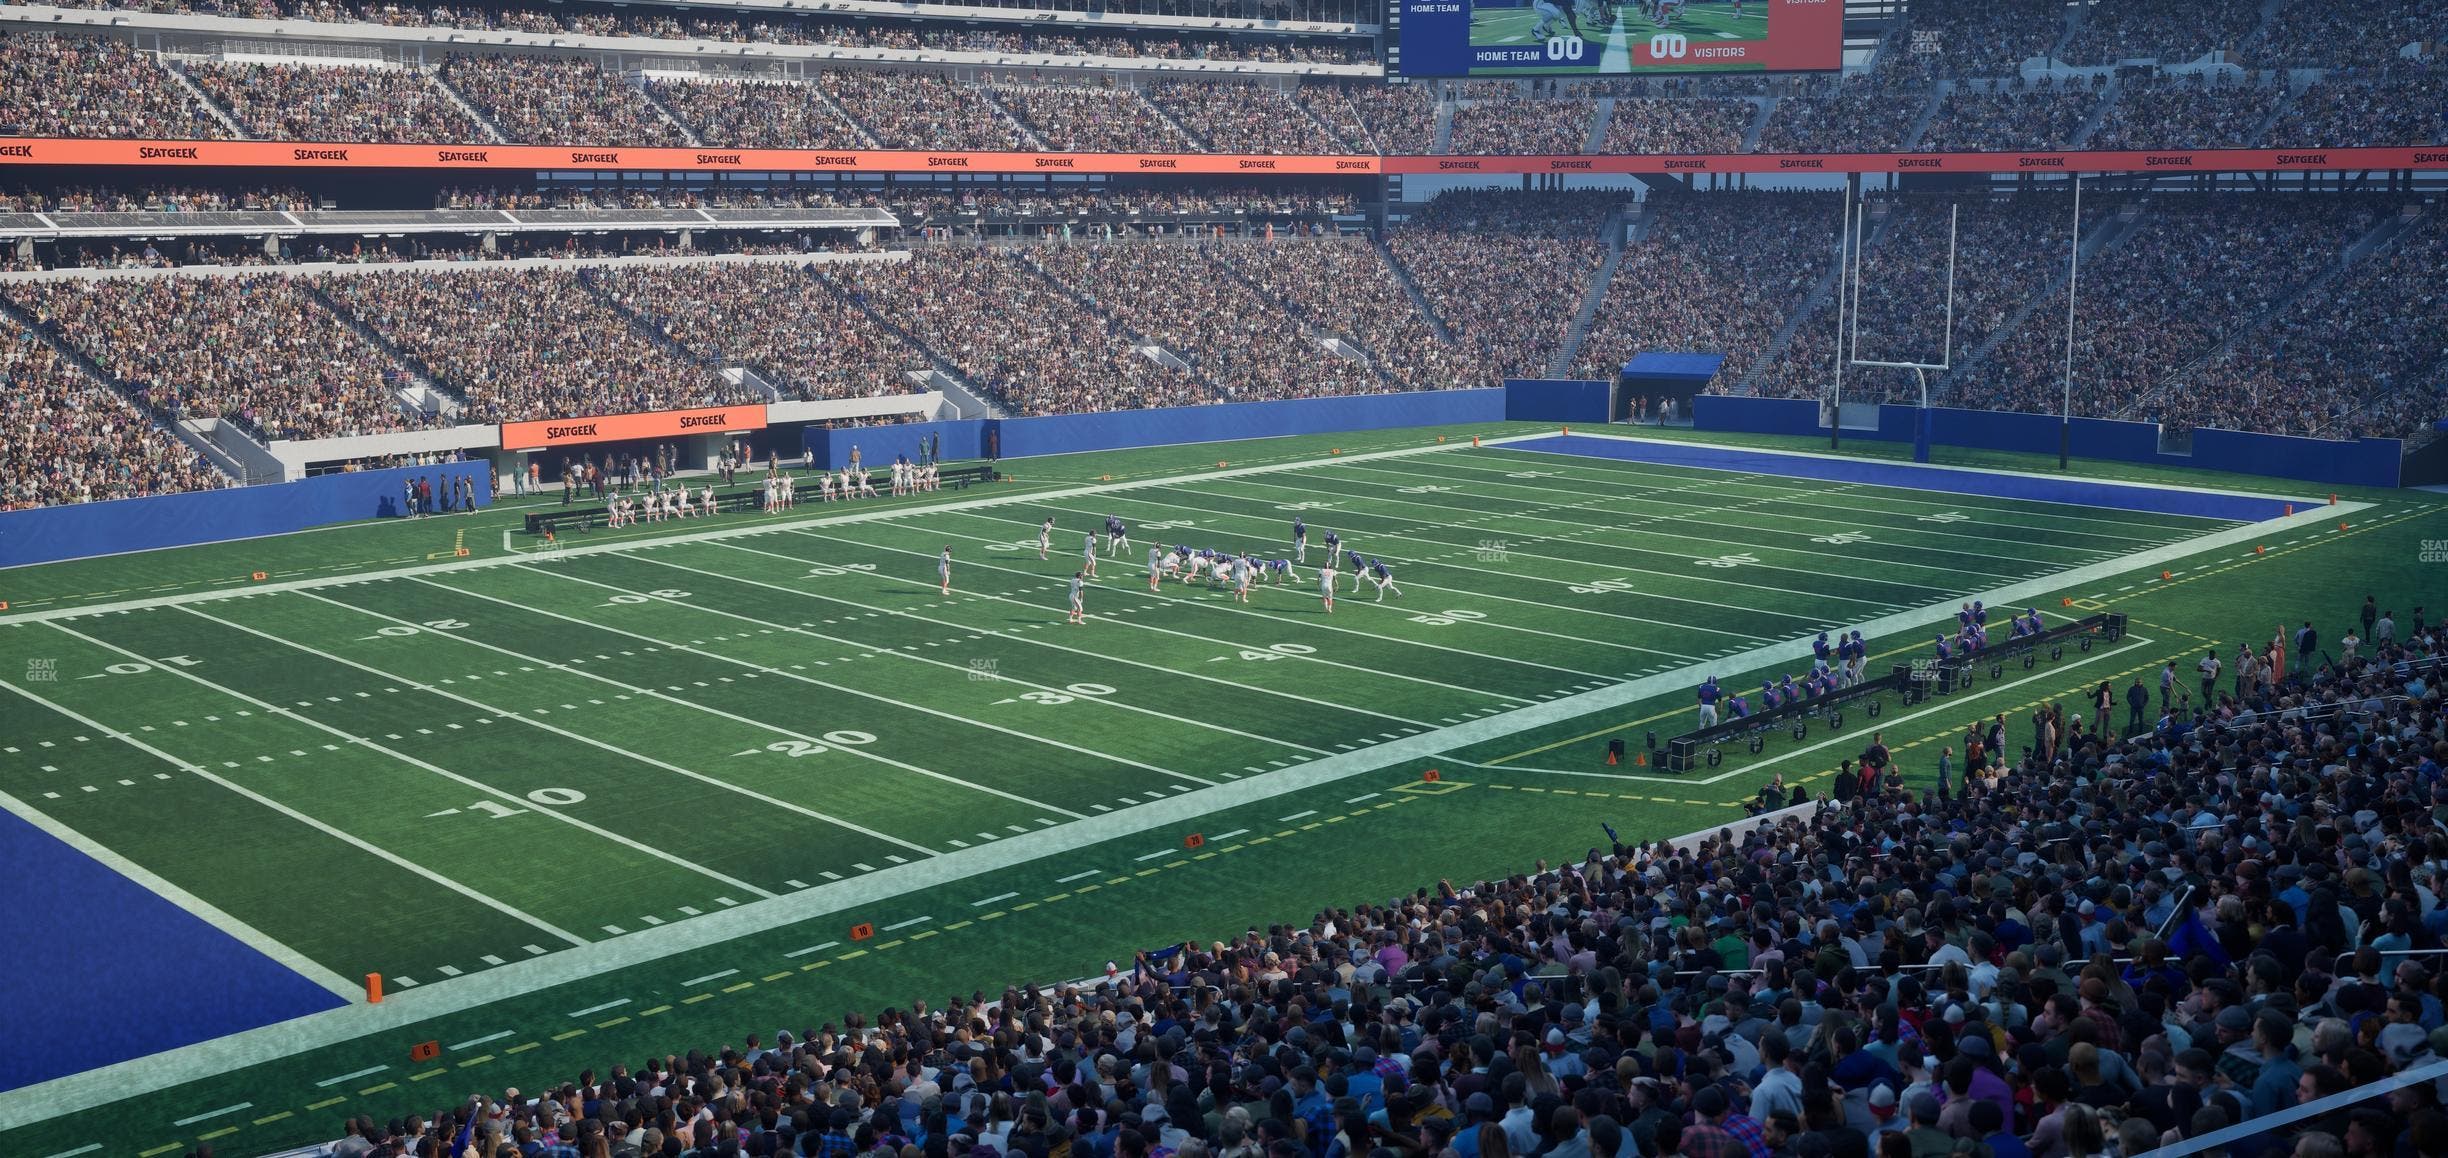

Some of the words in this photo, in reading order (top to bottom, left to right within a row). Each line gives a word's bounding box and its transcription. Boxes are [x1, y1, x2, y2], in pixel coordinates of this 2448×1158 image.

[1410, 4, 1435, 13] HOME
[1436, 4, 1460, 12] TEAM
[1476, 51, 1508, 61] HOME
[1510, 51, 1540, 61] TEAM
[1547, 36, 1583, 60] 00
[1650, 33, 1687, 58] 00
[1694, 47, 1746, 58] VISITORS
[140, 146, 198, 159] SEATGEEK
[294, 149, 349, 161] SEATGEEK
[438, 151, 488, 162] SEATGEEK
[572, 152, 618, 164] SEATGEEK
[696, 154, 741, 165] SEATGEEK
[815, 156, 857, 165] SEATGEEK
[928, 157, 968, 167] SEATGEEK
[1035, 158, 1074, 167] SEATGEEK
[1140, 160, 1176, 169] SEATGEEK
[1239, 161, 1275, 169] SEATGEEK
[1439, 161, 1480, 169] SEATGEEK
[1550, 161, 1592, 169] SEATGEEK
[1663, 160, 1706, 168] SEATGEEK
[1780, 159, 1823, 168] SEATGEEK
[1897, 158, 1941, 168] SEATGEEK
[2020, 158, 2065, 167] SEATGEEK
[2145, 156, 2193, 166] SEATGEEK
[2277, 154, 2327, 165] SEATGEEK
[1336, 161, 1369, 170] SEATGEEK
[680, 413, 727, 429] SEATGEEK
[546, 424, 597, 439] SEATGEEK
[1569, 580, 1633, 594] 40
[1406, 610, 1487, 625] 50
[377, 619, 470, 637] 20
[1239, 643, 1317, 661] 40
[105, 655, 204, 674] 10
[1020, 683, 1116, 704] 30
[767, 730, 877, 757] 20
[466, 787, 586, 818] 10
[858, 926, 868, 937] 10
[423, 1044, 431, 1057] G
